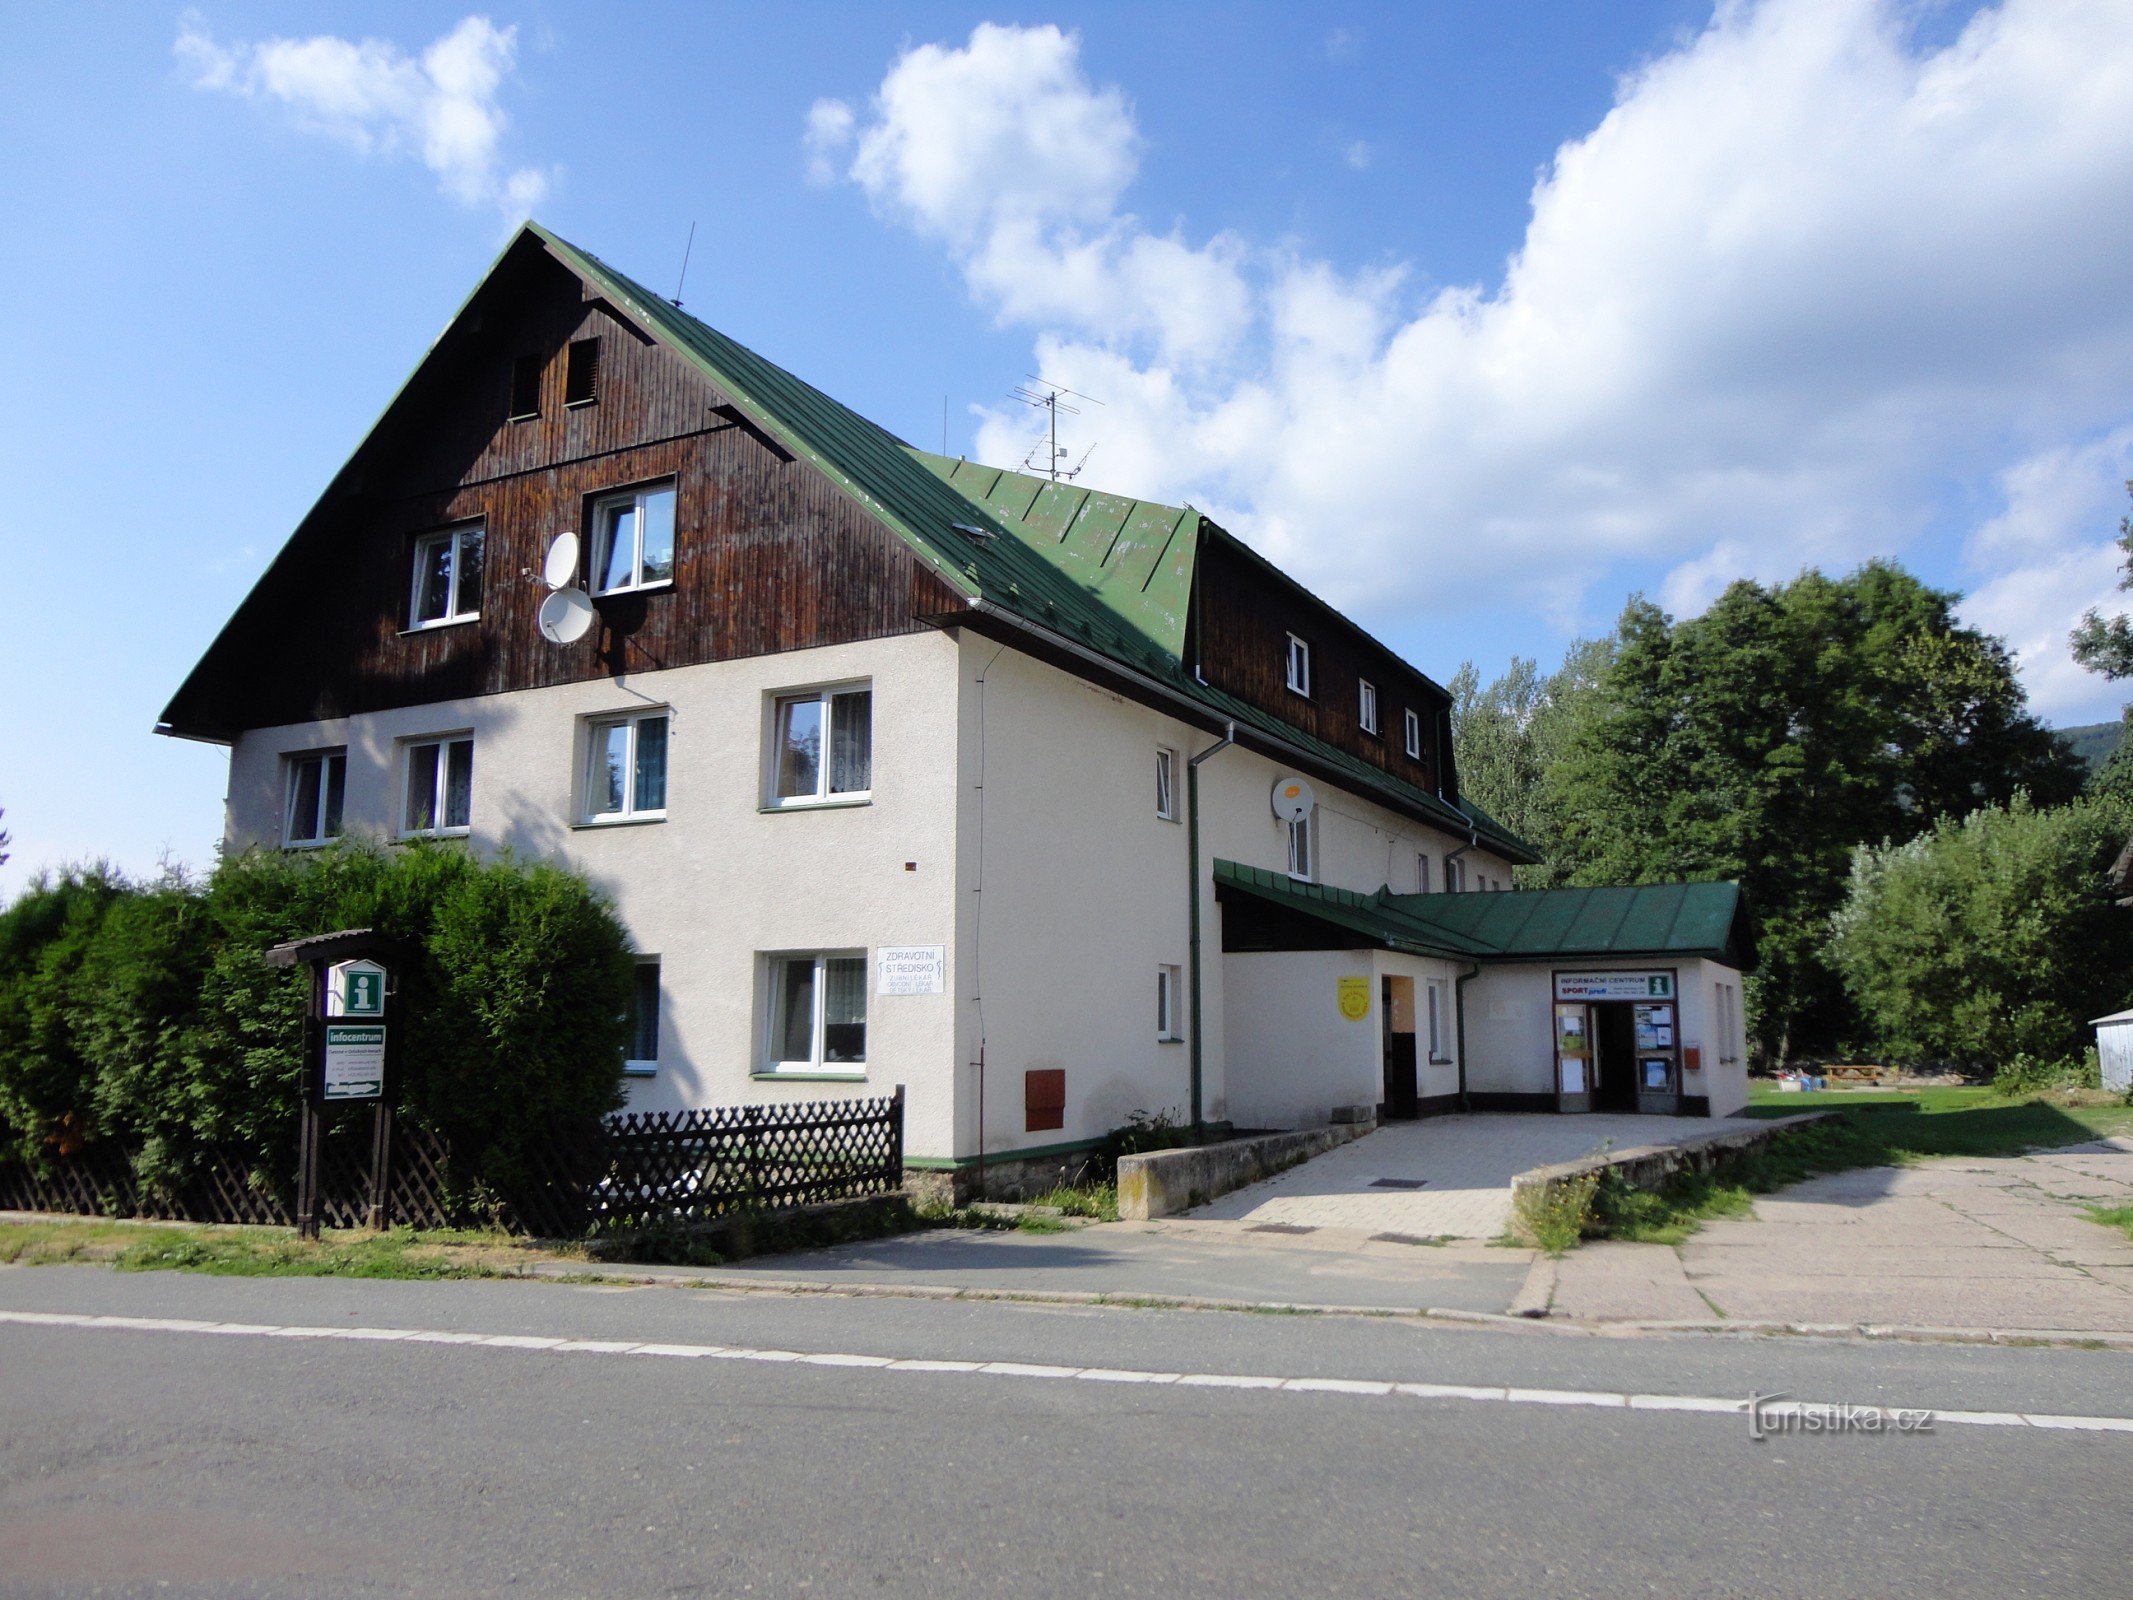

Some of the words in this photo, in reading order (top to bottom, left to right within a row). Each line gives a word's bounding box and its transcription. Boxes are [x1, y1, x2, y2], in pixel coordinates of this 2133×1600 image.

[886, 949, 935, 961] ZDRAVOTNÍ
[886, 962, 934, 973] STŘEDISKO
[330, 1031, 382, 1042] infocentrum
